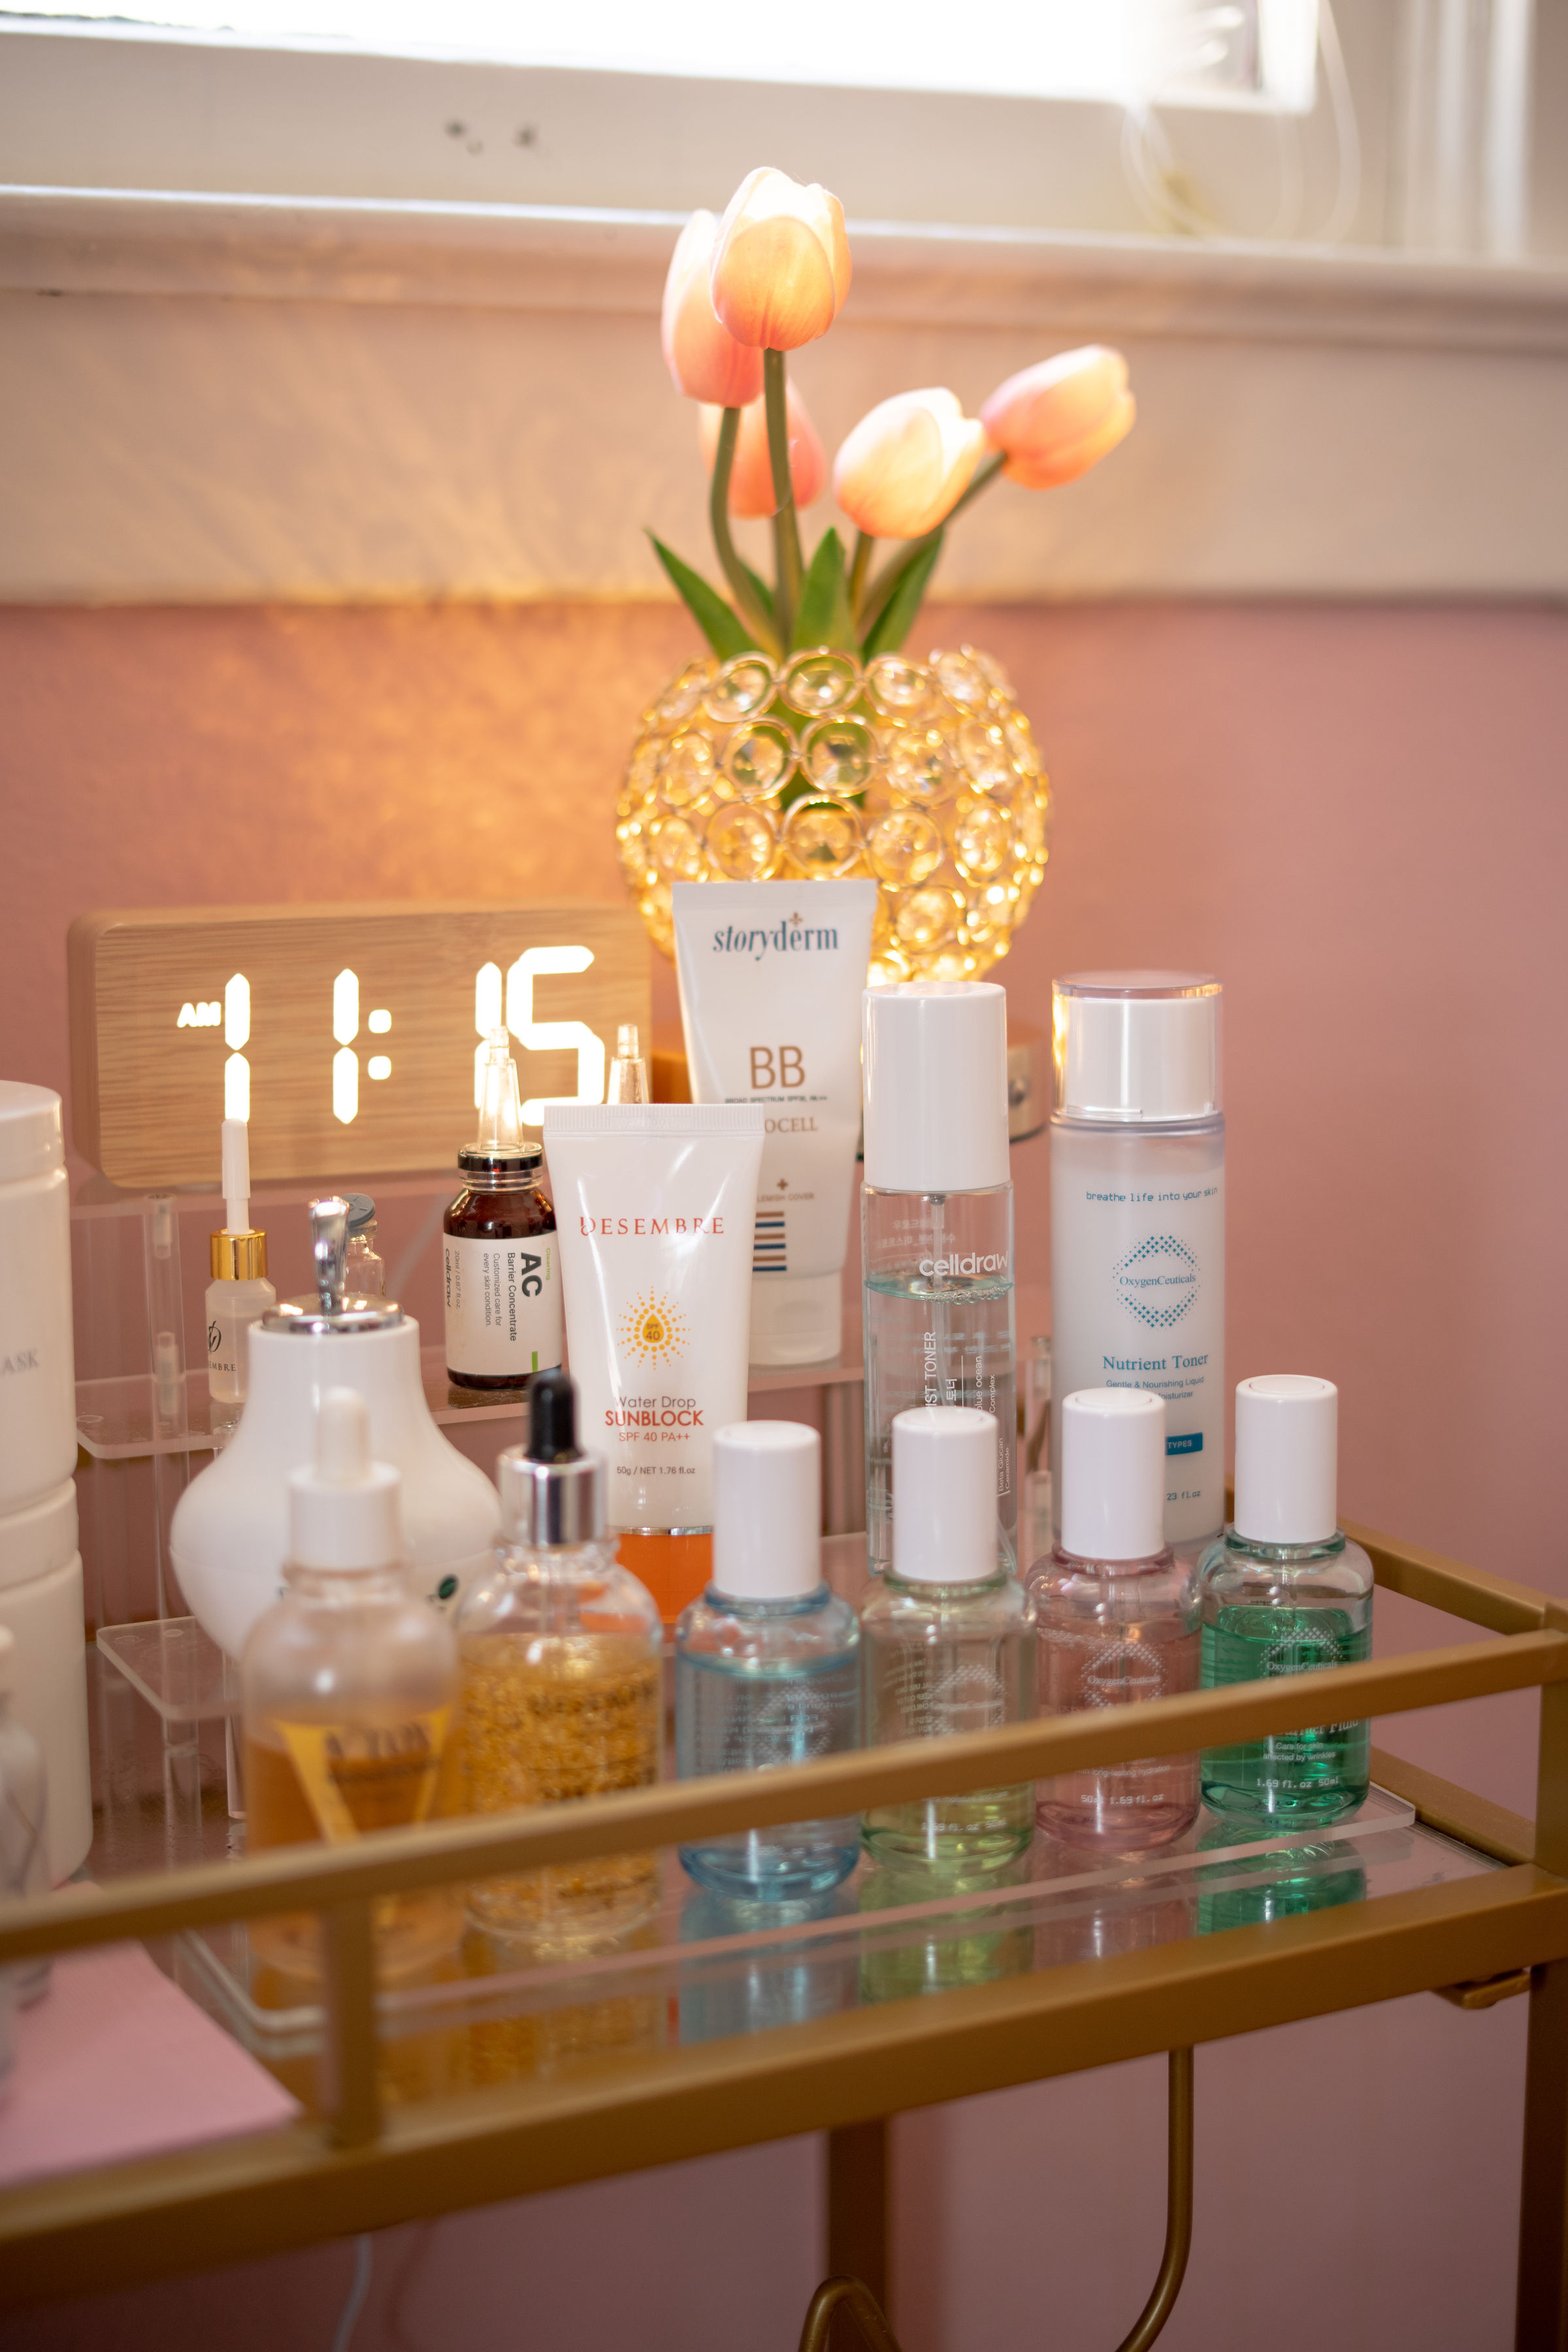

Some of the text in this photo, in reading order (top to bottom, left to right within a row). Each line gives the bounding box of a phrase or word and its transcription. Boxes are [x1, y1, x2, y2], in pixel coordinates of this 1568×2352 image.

[713, 920, 840, 961] storyderm
[176, 1001, 221, 1028] AM
[749, 1046, 806, 1089] BB
[764, 1117, 819, 1134] OCELL
[757, 1192, 815, 1203] LEMISH COVER
[1086, 1186, 1218, 1202] breathe life into your skin
[580, 1216, 725, 1236] DESEMBRE
[919, 1250, 1009, 1277] celldraw
[493, 1252, 502, 1297] Customized
[521, 1252, 543, 1298] AC
[1119, 1273, 1196, 1288] OxygenCeuticals
[507, 1252, 517, 1341] Barrier Concentrate
[645, 1330, 661, 1341] 40
[1, 1348, 41, 1375] ASK
[209, 1361, 237, 1371] EMBRE
[923, 1331, 938, 1407] IST TONER
[1102, 1354, 1209, 1370] Nutrient Toner
[945, 1378, 958, 1401] 토너
[1106, 1379, 1132, 1388] Gentle
[1142, 1379, 1183, 1388] Nourishing
[1185, 1377, 1204, 1386] Liquid
[661, 1396, 696, 1410] Drop
[1158, 1391, 1194, 1400] oisturizer
[604, 1409, 705, 1428] SUNBLOCK
[619, 1431, 691, 1442] SPF 40 PA++
[1167, 1439, 1193, 1449] TYPES
[617, 1466, 632, 1476] 50g
[640, 1466, 657, 1475] NET
[659, 1466, 677, 1475] 1.76
[679, 1466, 696, 1475] fl.oz
[1166, 1492, 1177, 1501] 23
[1275, 1741, 1323, 1750] Care for skin
[1296, 1753, 1305, 1762] by
[1307, 1751, 1337, 1759] wrinkles
[1256, 1778, 1279, 1788] 1.69
[1299, 1780, 1313, 1789] oz
[1318, 1776, 1339, 1788] 50ml
[1109, 1795, 1134, 1805] 1.69
